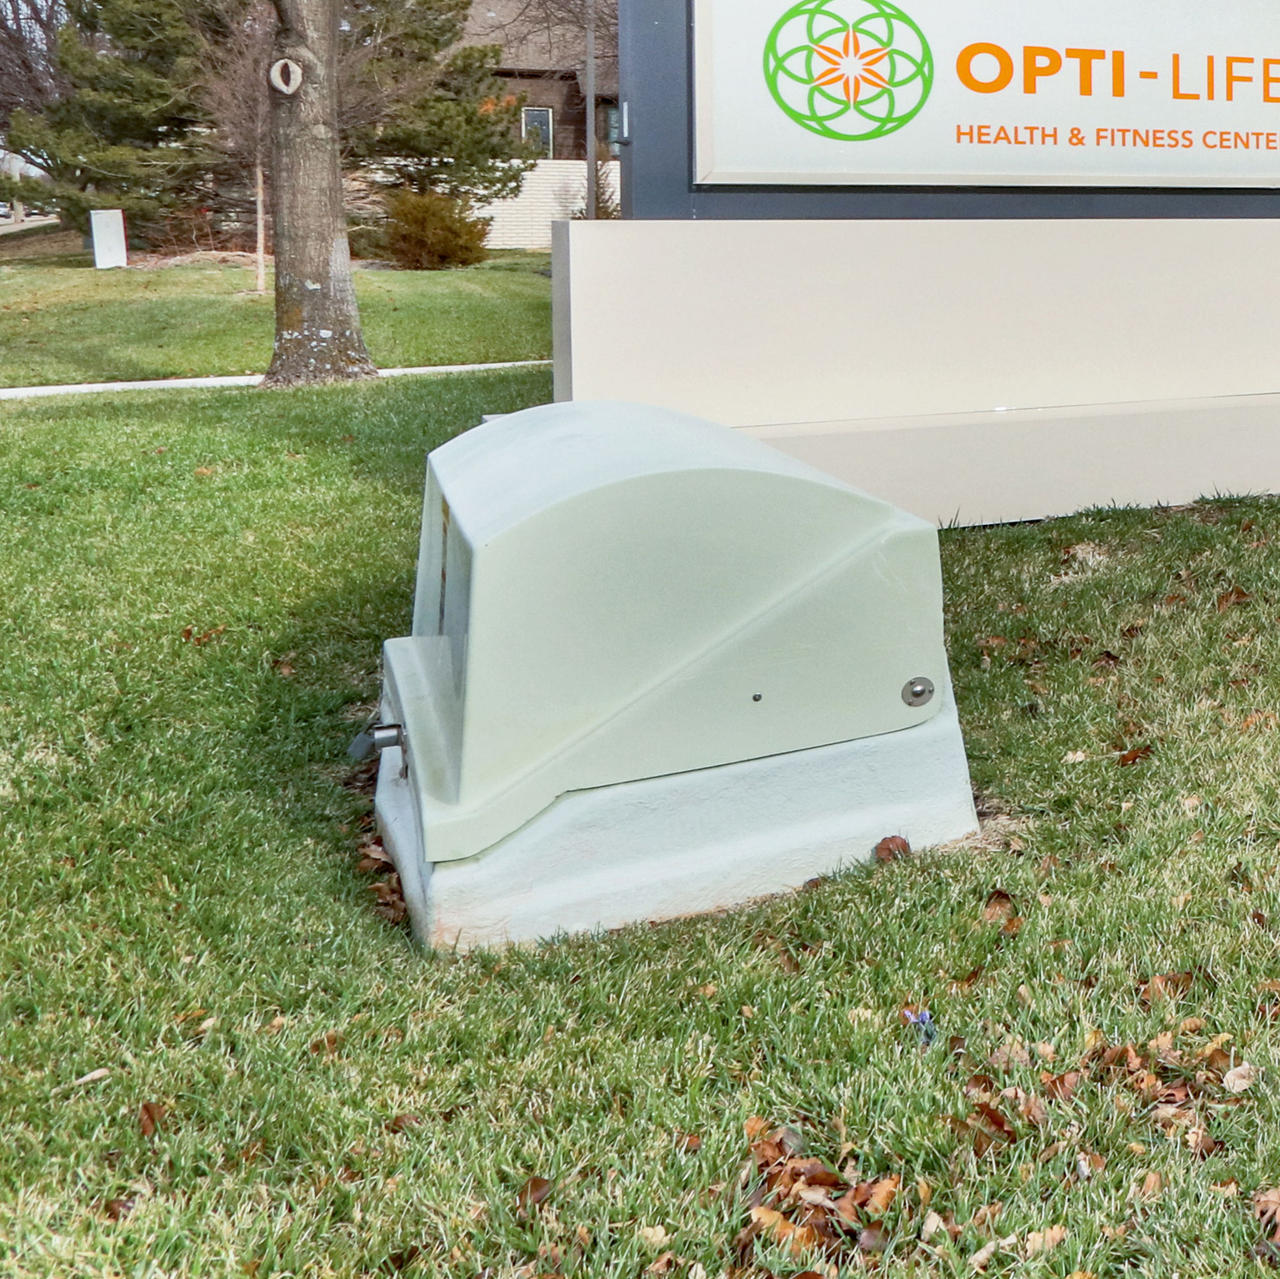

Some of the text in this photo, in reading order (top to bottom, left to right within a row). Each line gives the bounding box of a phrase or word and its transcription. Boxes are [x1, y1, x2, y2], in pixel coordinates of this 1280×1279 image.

[955, 124, 1059, 145] HEALTH
[1067, 127, 1085, 147] &
[1095, 127, 1194, 149] FITNESS
